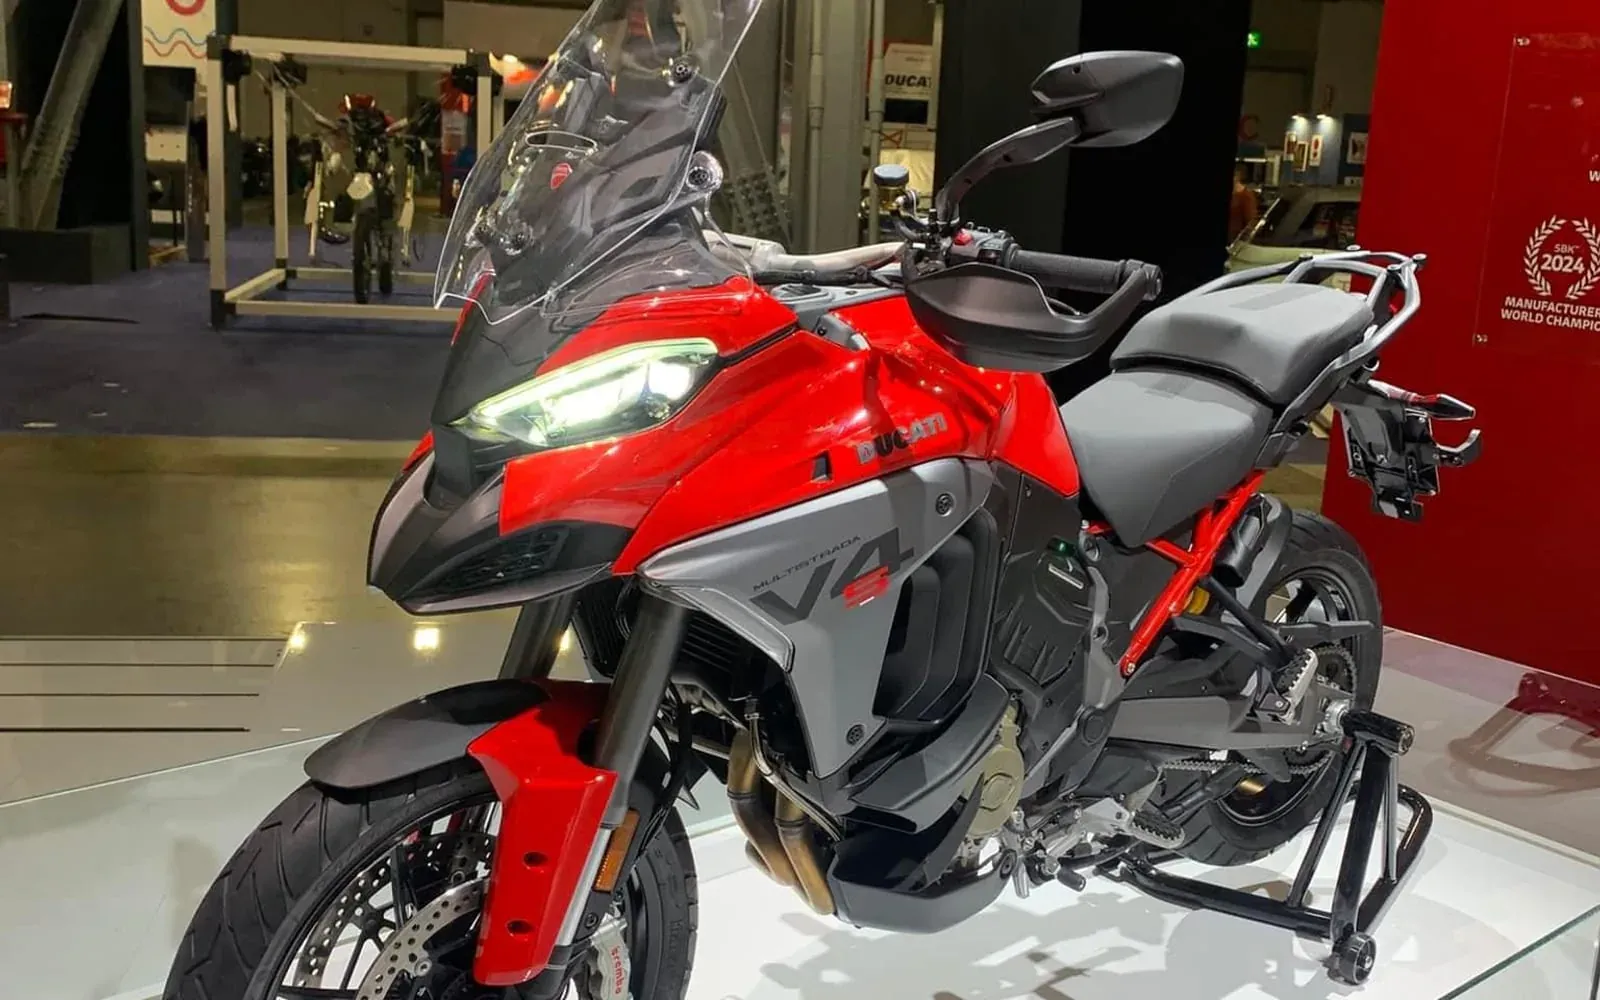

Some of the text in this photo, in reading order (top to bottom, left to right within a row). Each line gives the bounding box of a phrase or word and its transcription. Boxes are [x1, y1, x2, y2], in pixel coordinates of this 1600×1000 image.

[1541, 254, 1585, 273] 2024
[1501, 308, 1544, 323] WORLD
[857, 412, 948, 464] DUCATI
[753, 535, 861, 592] MULTISTRADA
[611, 945, 625, 994] brembo
